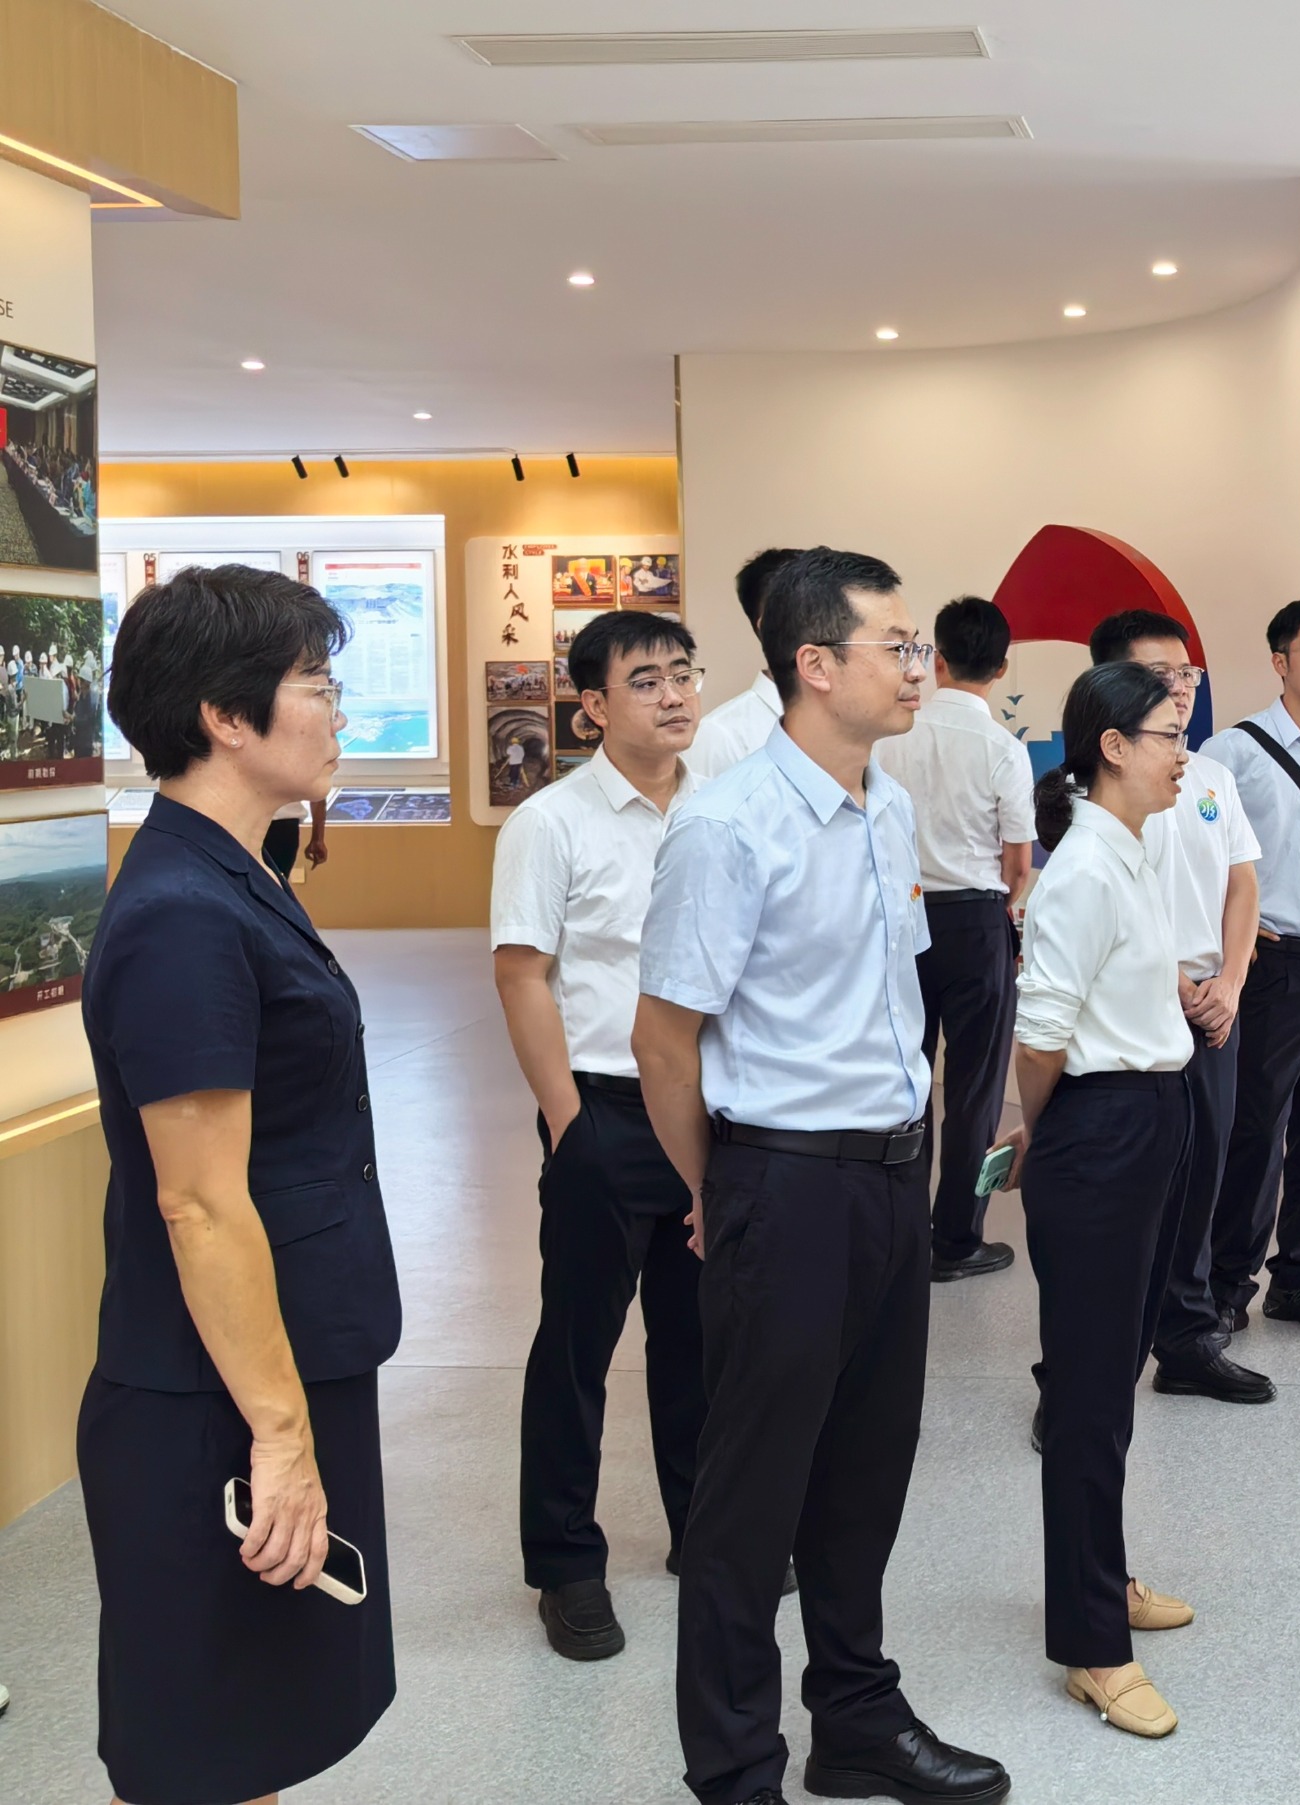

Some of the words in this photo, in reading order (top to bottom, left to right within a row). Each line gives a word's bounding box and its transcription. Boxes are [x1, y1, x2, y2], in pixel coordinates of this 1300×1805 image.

[502, 544, 529, 646] 水利人风采
